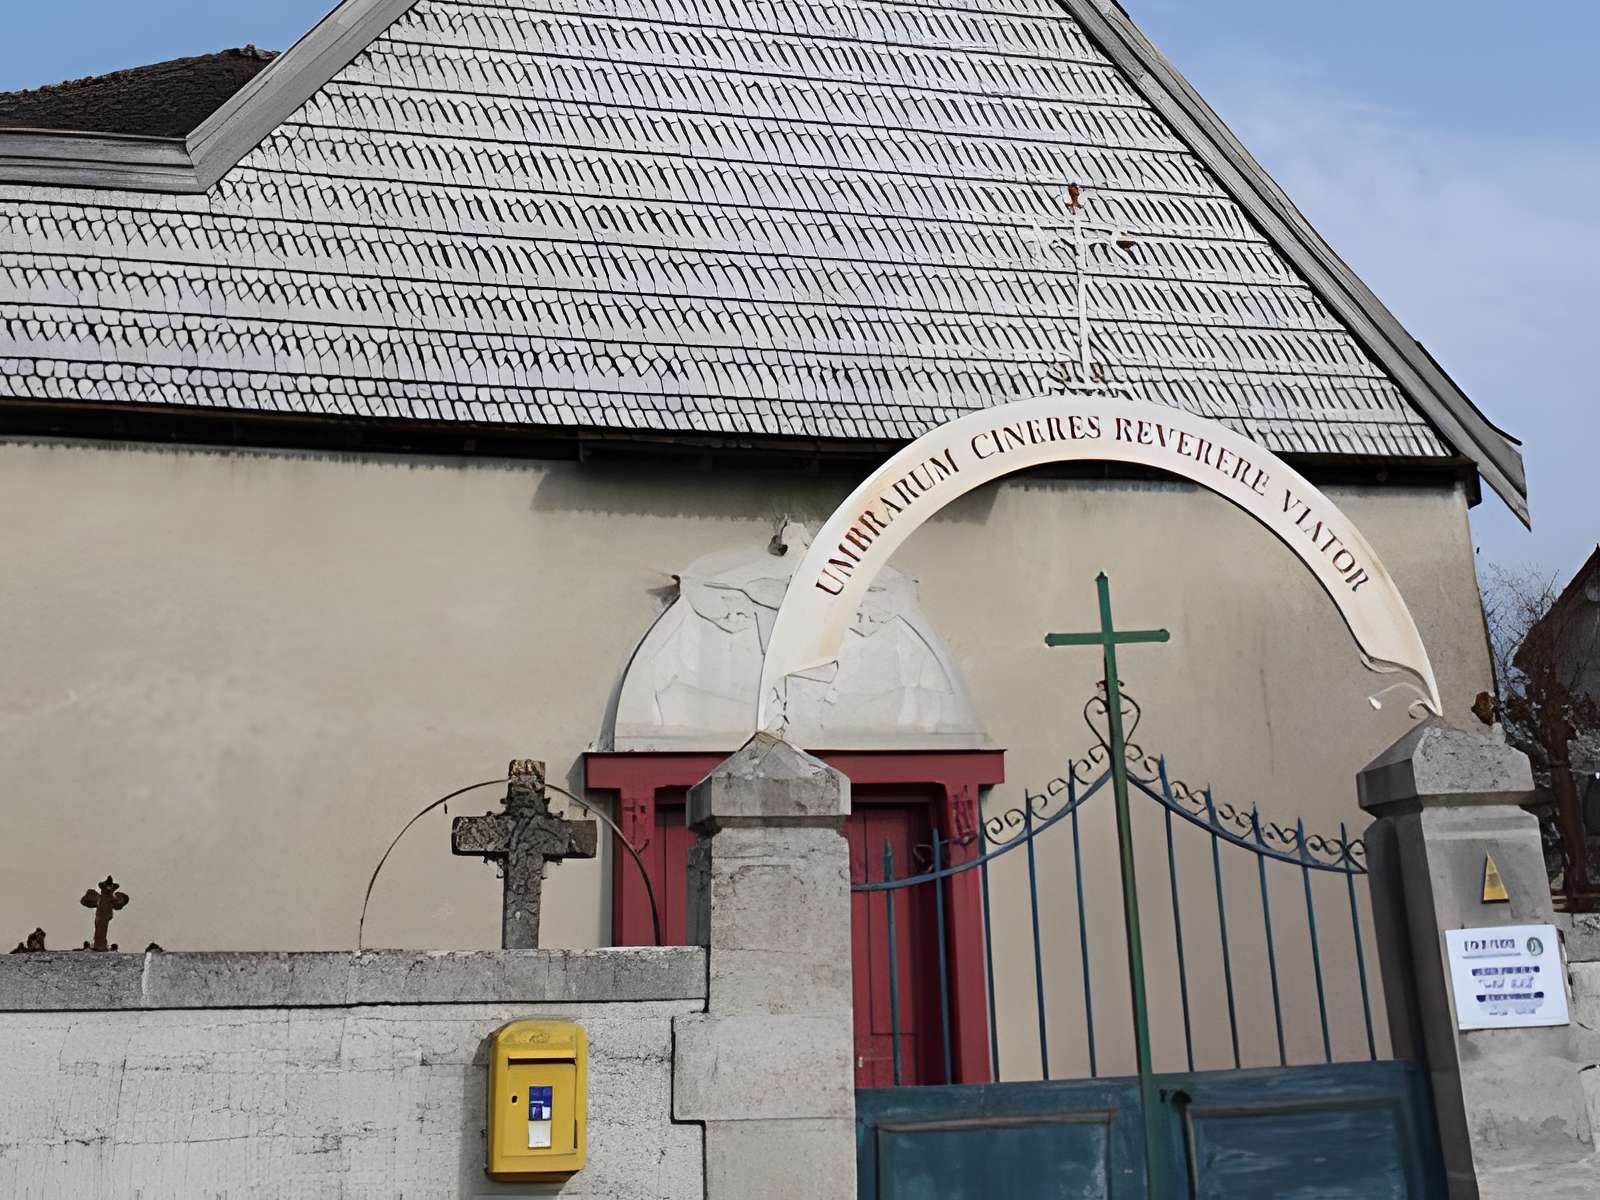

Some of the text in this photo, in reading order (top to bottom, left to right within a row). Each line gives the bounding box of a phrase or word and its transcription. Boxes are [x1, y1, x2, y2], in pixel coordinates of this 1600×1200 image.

[815, 416, 1369, 595] UMBRARUM CINERES REVERERE VIATOR
